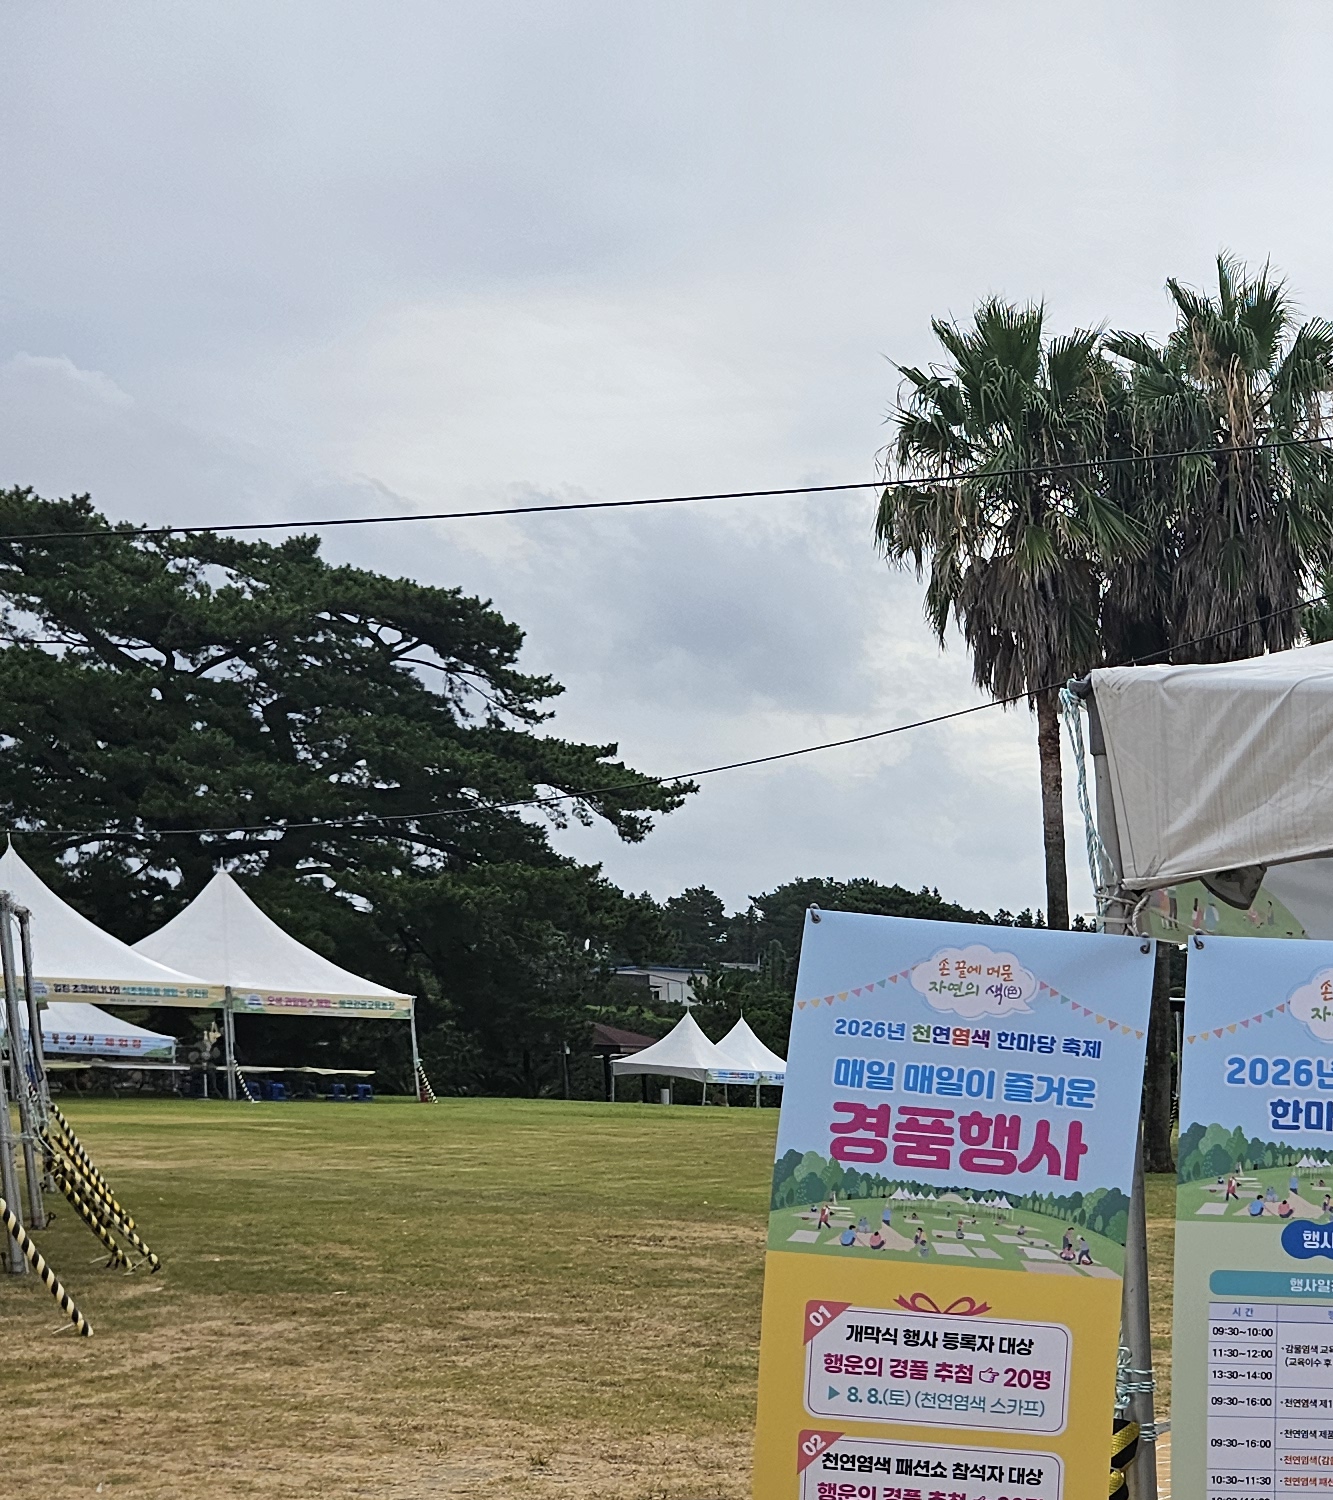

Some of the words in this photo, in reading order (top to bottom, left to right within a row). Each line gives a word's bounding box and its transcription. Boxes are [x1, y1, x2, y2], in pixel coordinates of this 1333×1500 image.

[938, 959, 950, 976] 손
[955, 960, 981, 977] 끝에
[987, 965, 1014, 981] 머문
[928, 980, 979, 997] 자연의
[834, 1018, 906, 1041] 2026년
[913, 1024, 990, 1048] 천연염색
[997, 1032, 1056, 1055] 한마당
[1062, 1037, 1102, 1059] 축제
[834, 1058, 895, 1090] 매일
[903, 1065, 995, 1100] 매일이
[1003, 1072, 1096, 1108] 즐거운
[829, 1102, 1088, 1180] 경품행사
[809, 1306, 831, 1327] 01
[846, 1325, 898, 1346] 개막식
[903, 1329, 938, 1348] 행사
[942, 1333, 995, 1353] 등록자
[999, 1337, 1034, 1356] 대상
[1212, 1326, 1273, 1338] 09:30~10:00
[1212, 1348, 1272, 1359] 11:30~12:00
[824, 1353, 883, 1377] 행운의
[890, 1358, 928, 1380] 경품
[934, 1362, 973, 1384] 추첨
[1003, 1367, 1051, 1390] 20명
[1212, 1370, 1272, 1381] 13:30~14:00
[1211, 1397, 1272, 1407] 09:30~16:00
[801, 1434, 826, 1456] 02
[1284, 1429, 1317, 1440] 천연염색
[822, 1452, 891, 1475] 천연염색
[895, 1458, 947, 1478] 패션쇼
[952, 1462, 1004, 1483] 참석자
[1008, 1467, 1043, 1485] 대상
[1211, 1476, 1271, 1486] 10:30~11:30
